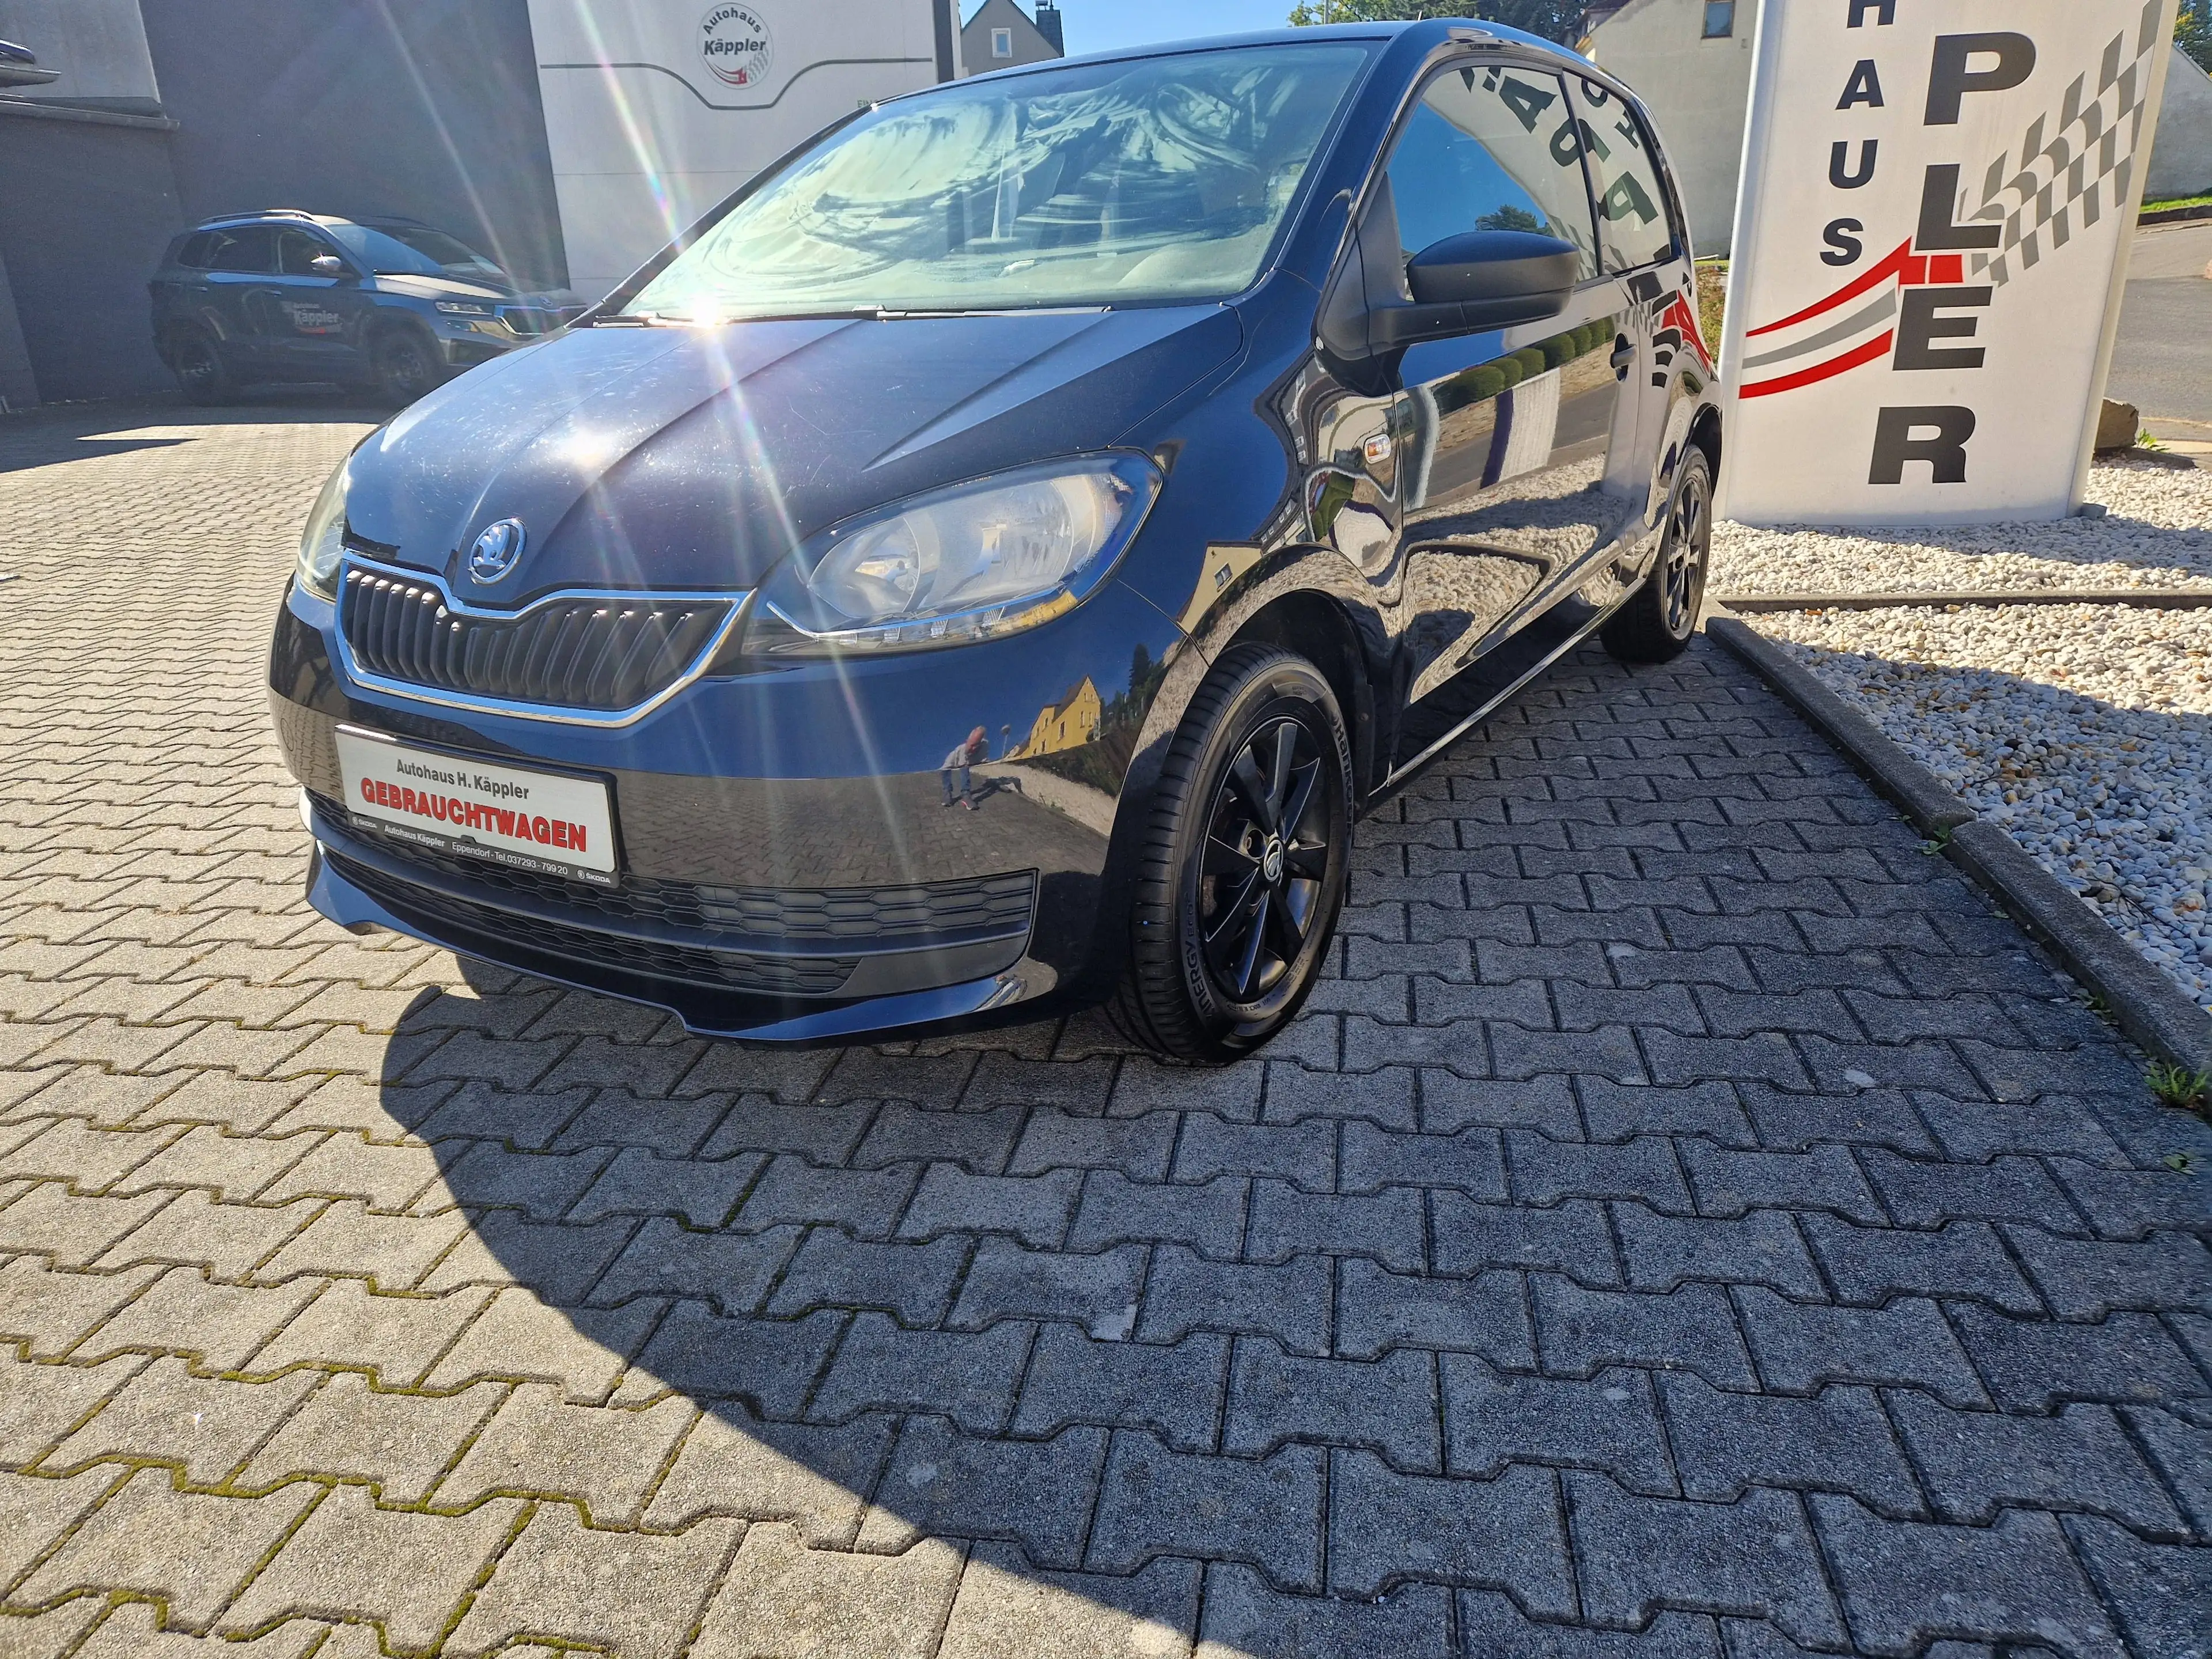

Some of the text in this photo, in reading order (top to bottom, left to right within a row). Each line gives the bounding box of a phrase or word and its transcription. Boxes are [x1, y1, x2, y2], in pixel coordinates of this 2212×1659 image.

[703, 7, 762, 35] Autohaus
[703, 38, 766, 55] Käppler
[1868, 31, 2036, 485] PLER
[294, 310, 340, 326] Käppler
[396, 759, 529, 799] Autohaus H. Käppler
[360, 777, 586, 853] GEBRAUCHTWAGEN
[384, 824, 416, 840] Autohaus
[417, 833, 445, 847] Käppler
[452, 842, 490, 858] Eppendorf
[585, 872, 611, 884] ŠKODA
